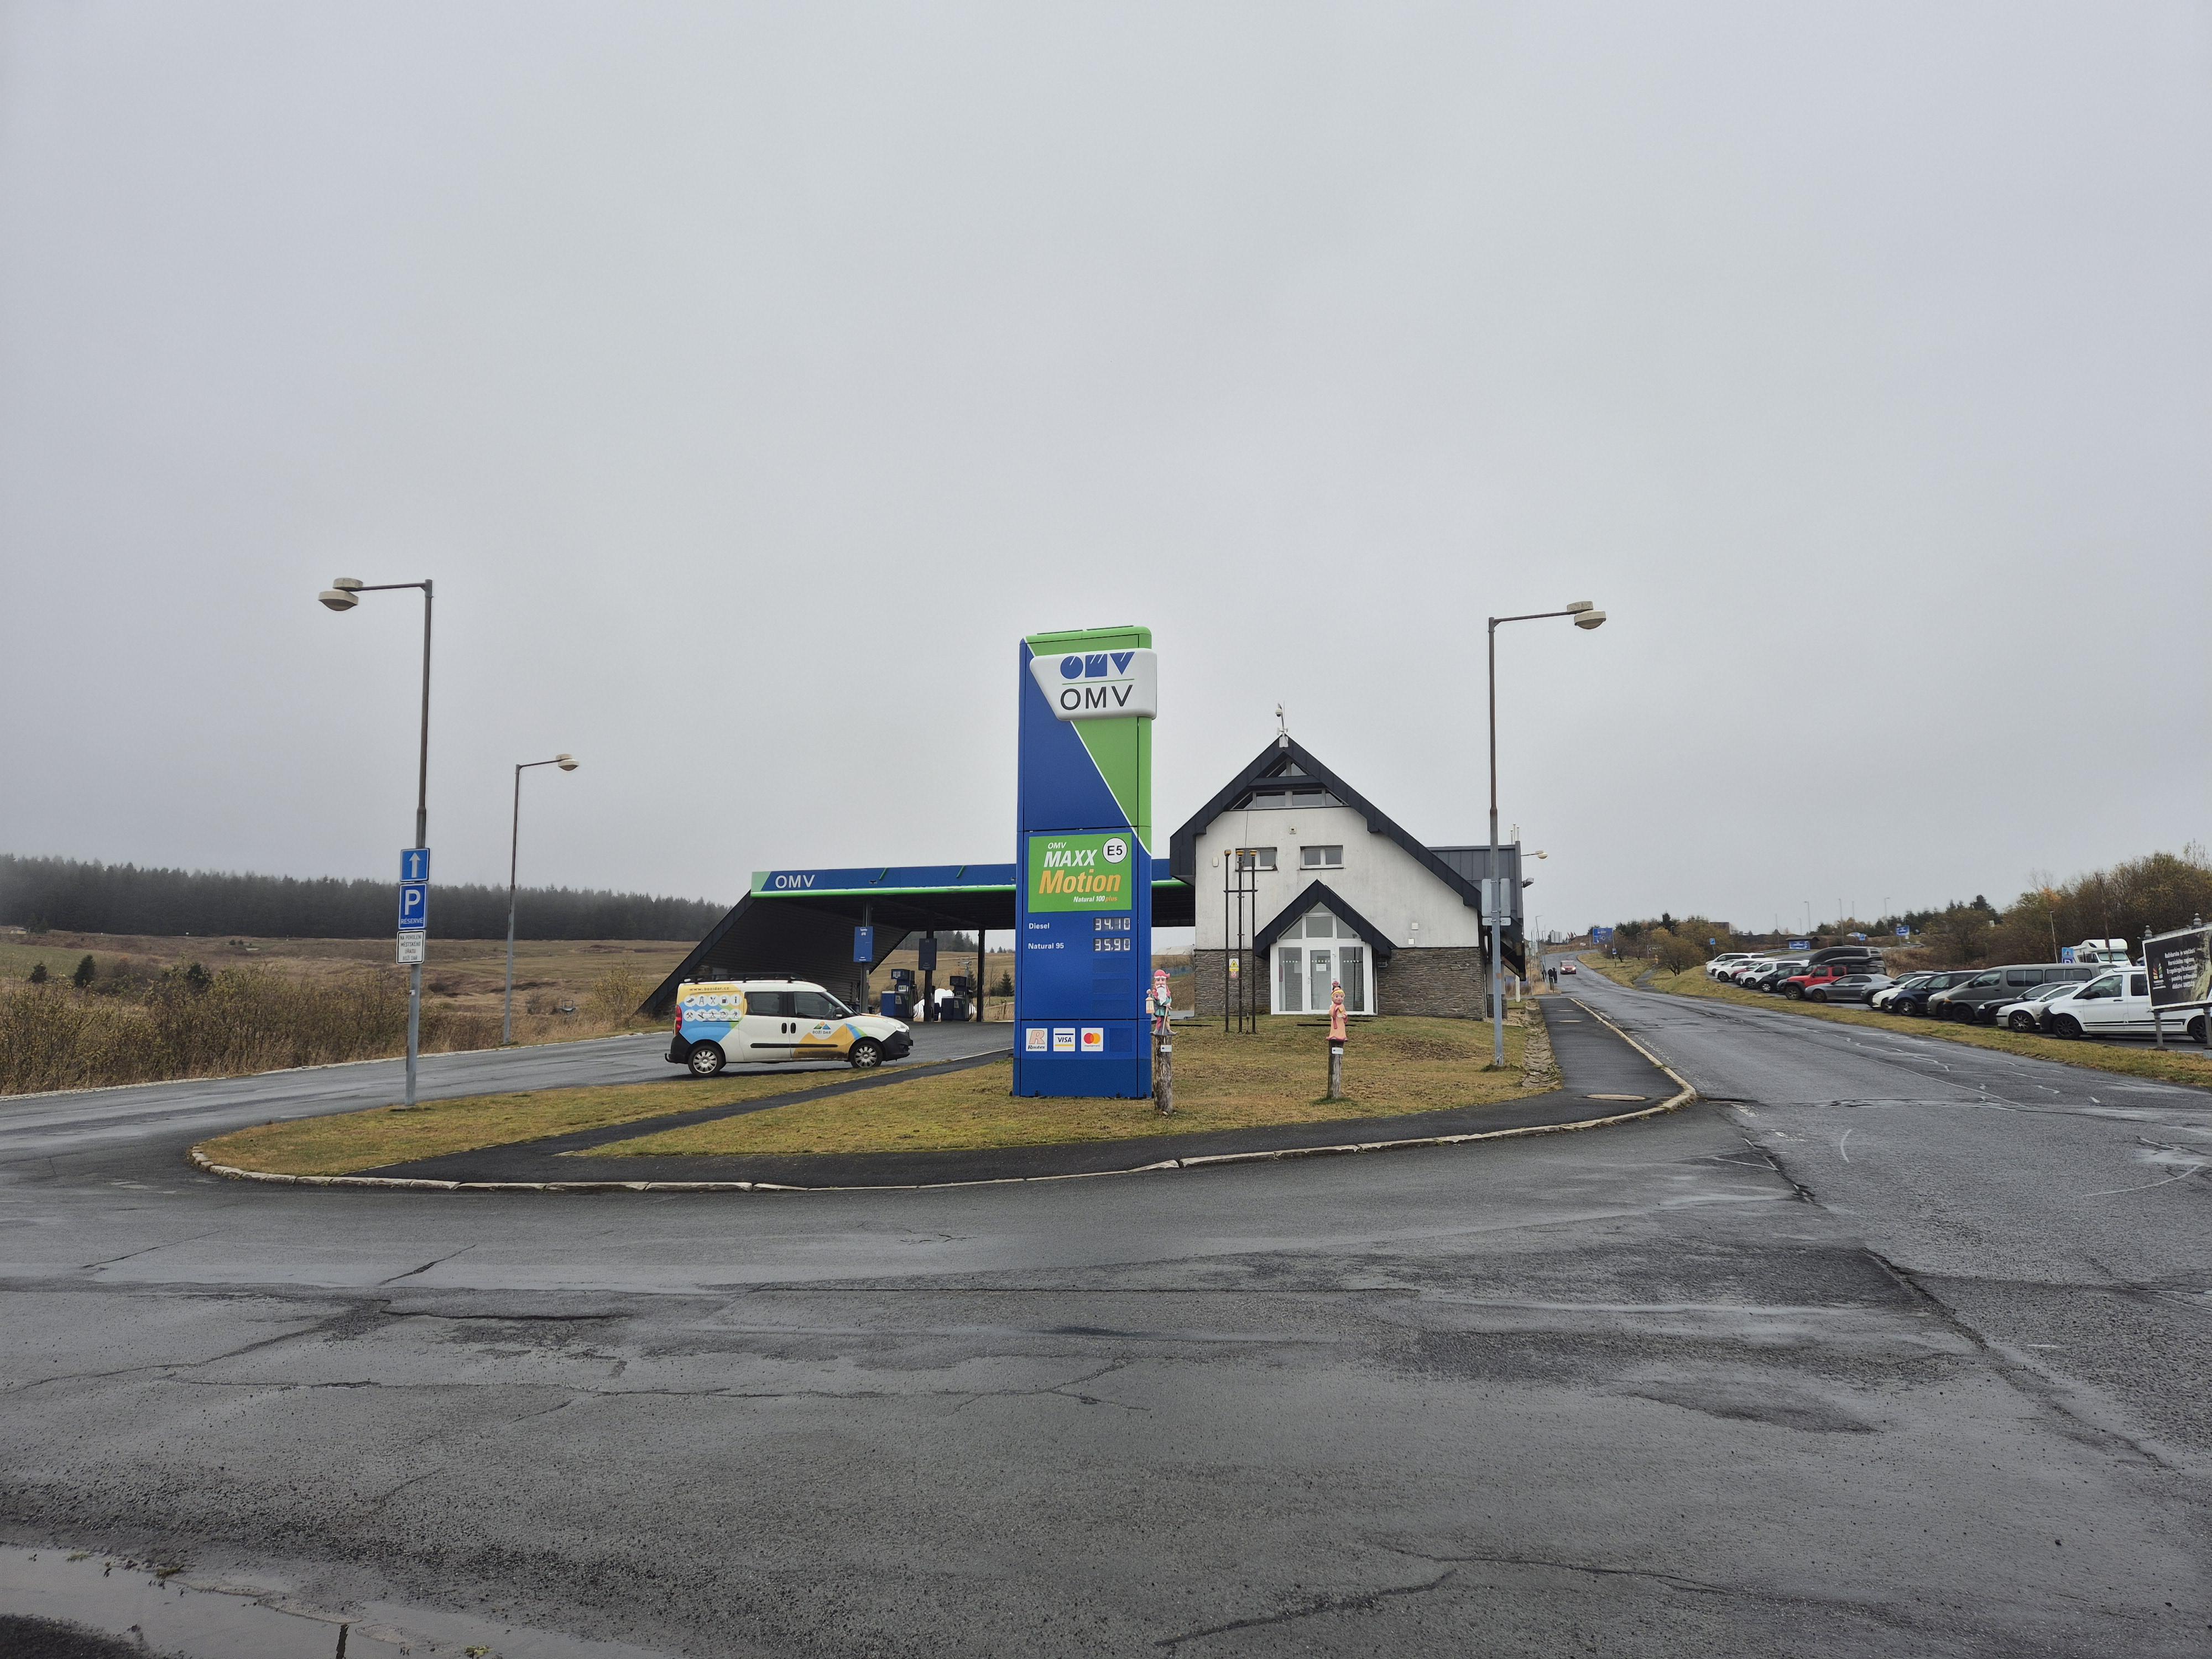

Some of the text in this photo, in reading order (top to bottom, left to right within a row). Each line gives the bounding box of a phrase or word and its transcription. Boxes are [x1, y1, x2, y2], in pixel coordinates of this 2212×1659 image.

[1060, 685, 1133, 710] OMV
[1044, 849, 1098, 868] MAXX
[1107, 846, 1123, 856] E5
[775, 874, 815, 889] OMV
[1039, 869, 1121, 894] Motion
[405, 889, 420, 915] P
